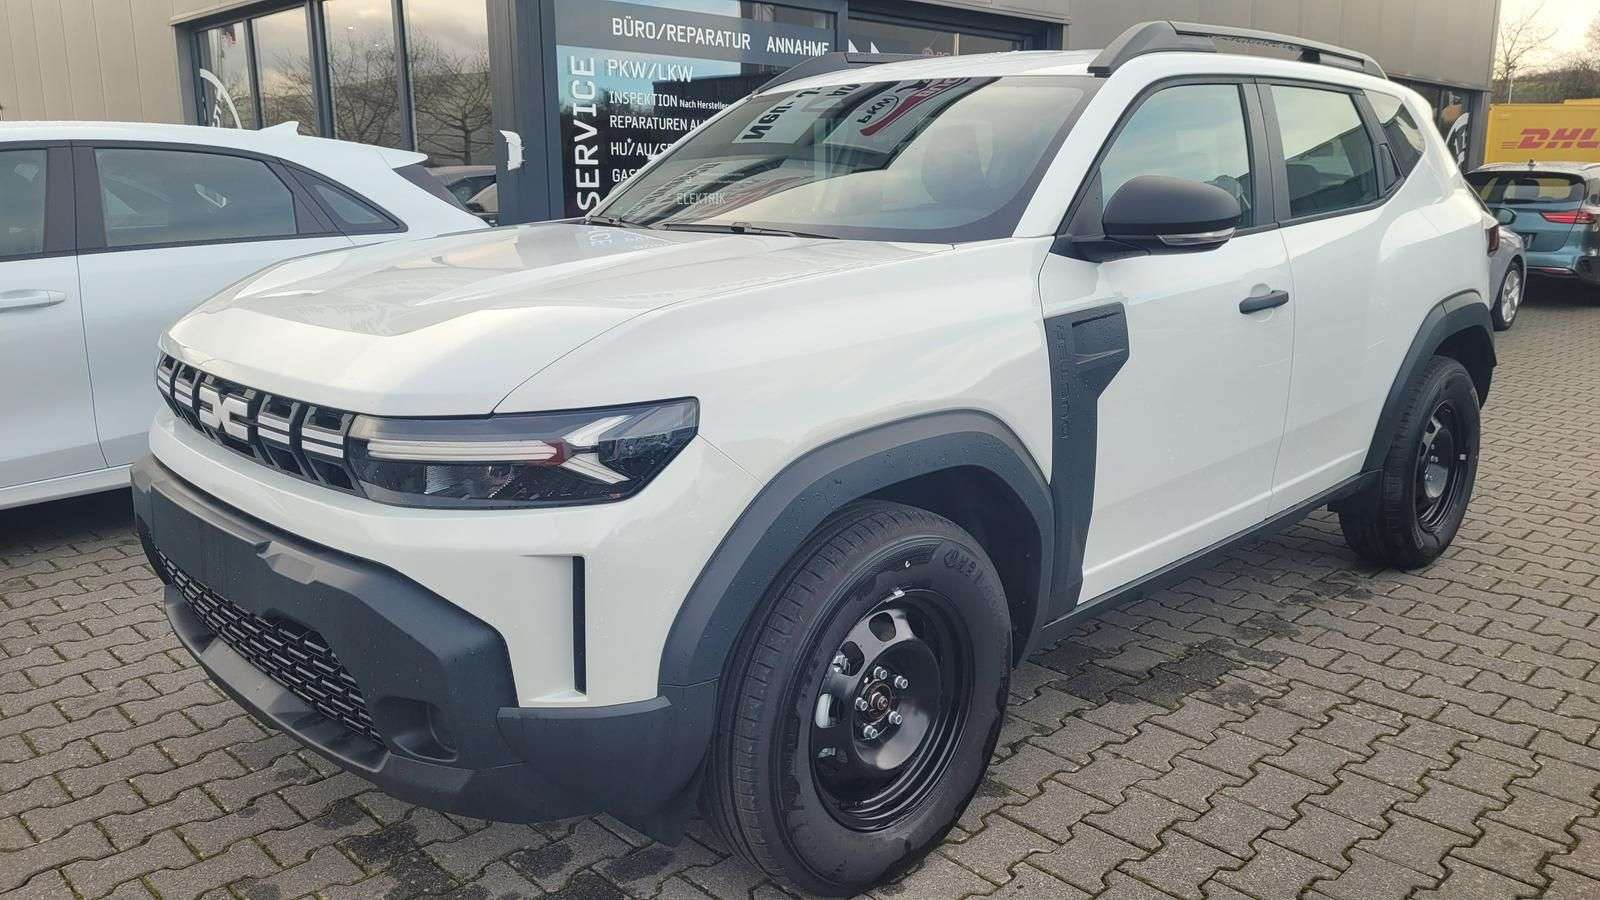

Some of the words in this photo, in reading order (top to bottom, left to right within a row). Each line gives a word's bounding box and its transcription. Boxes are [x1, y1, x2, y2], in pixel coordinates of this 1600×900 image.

[612, 15, 751, 50] BÜRO/REPARATUR
[608, 60, 694, 83] PKW/LKW
[609, 90, 678, 107] INSPEKTION
[680, 99, 697, 109] Nach
[570, 55, 600, 210] SERVICE
[609, 115, 688, 131] REPARATUREN
[1517, 128, 1600, 149] DHL
[612, 168, 641, 182] GAS
